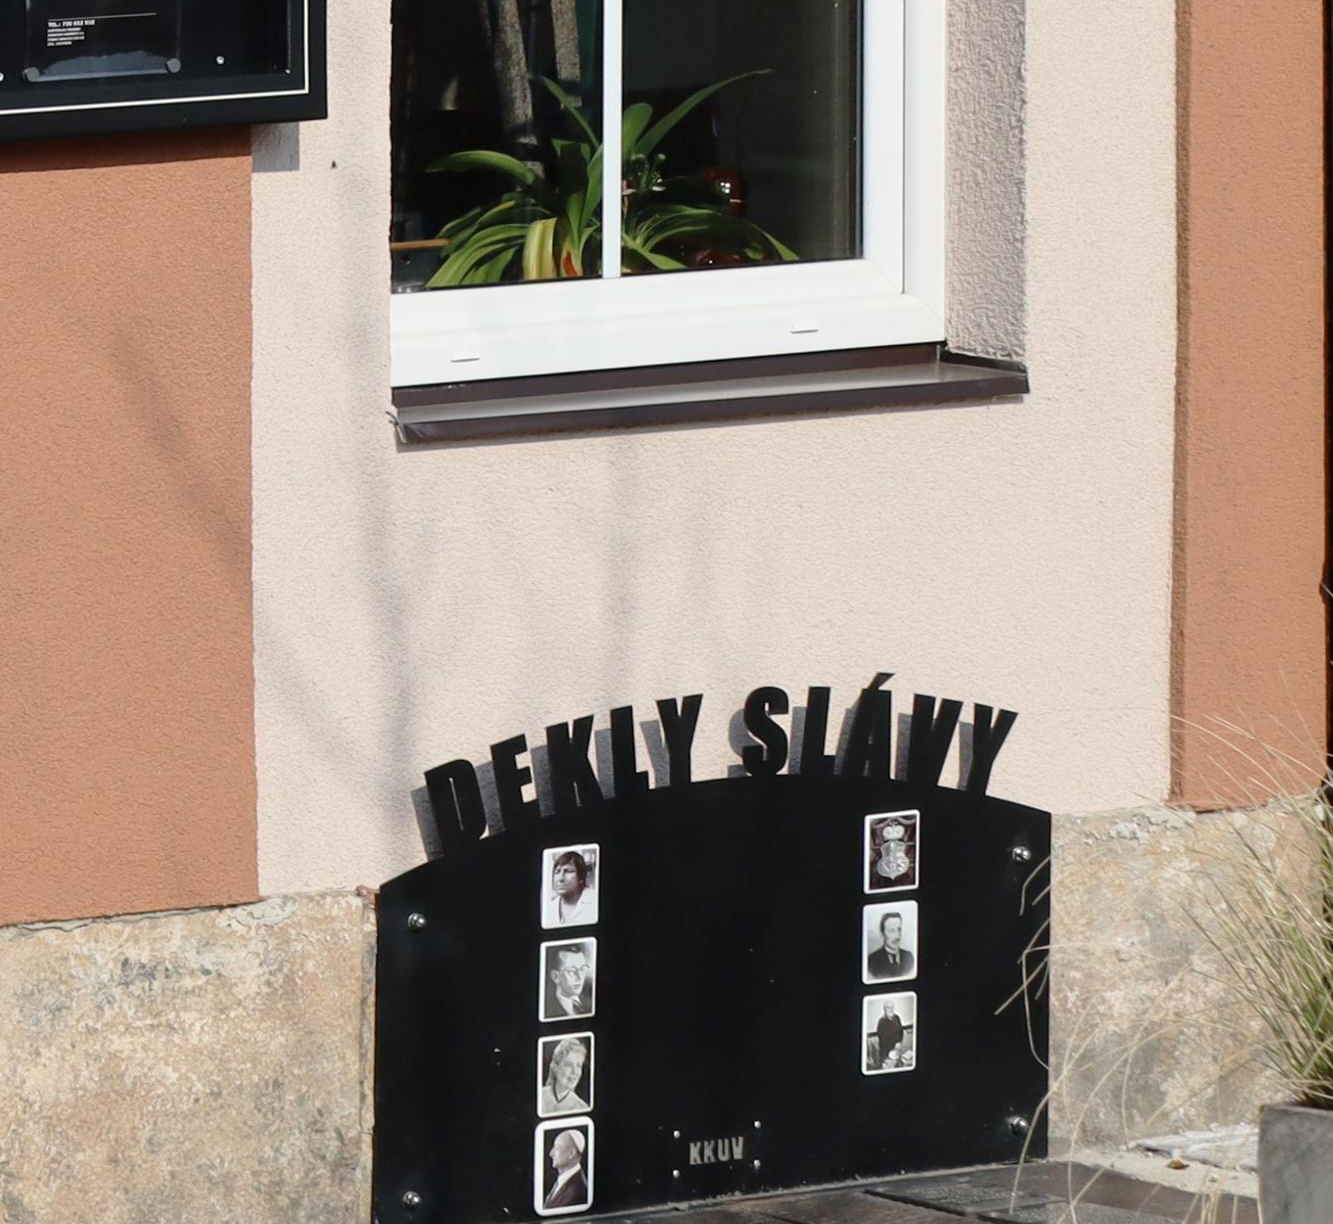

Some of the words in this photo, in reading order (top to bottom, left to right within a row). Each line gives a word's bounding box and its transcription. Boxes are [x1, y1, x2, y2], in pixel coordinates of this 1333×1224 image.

[424, 693, 703, 843] DEKLY
[742, 672, 1019, 795] SLÁVY
[689, 1136, 744, 1165] KKUV
